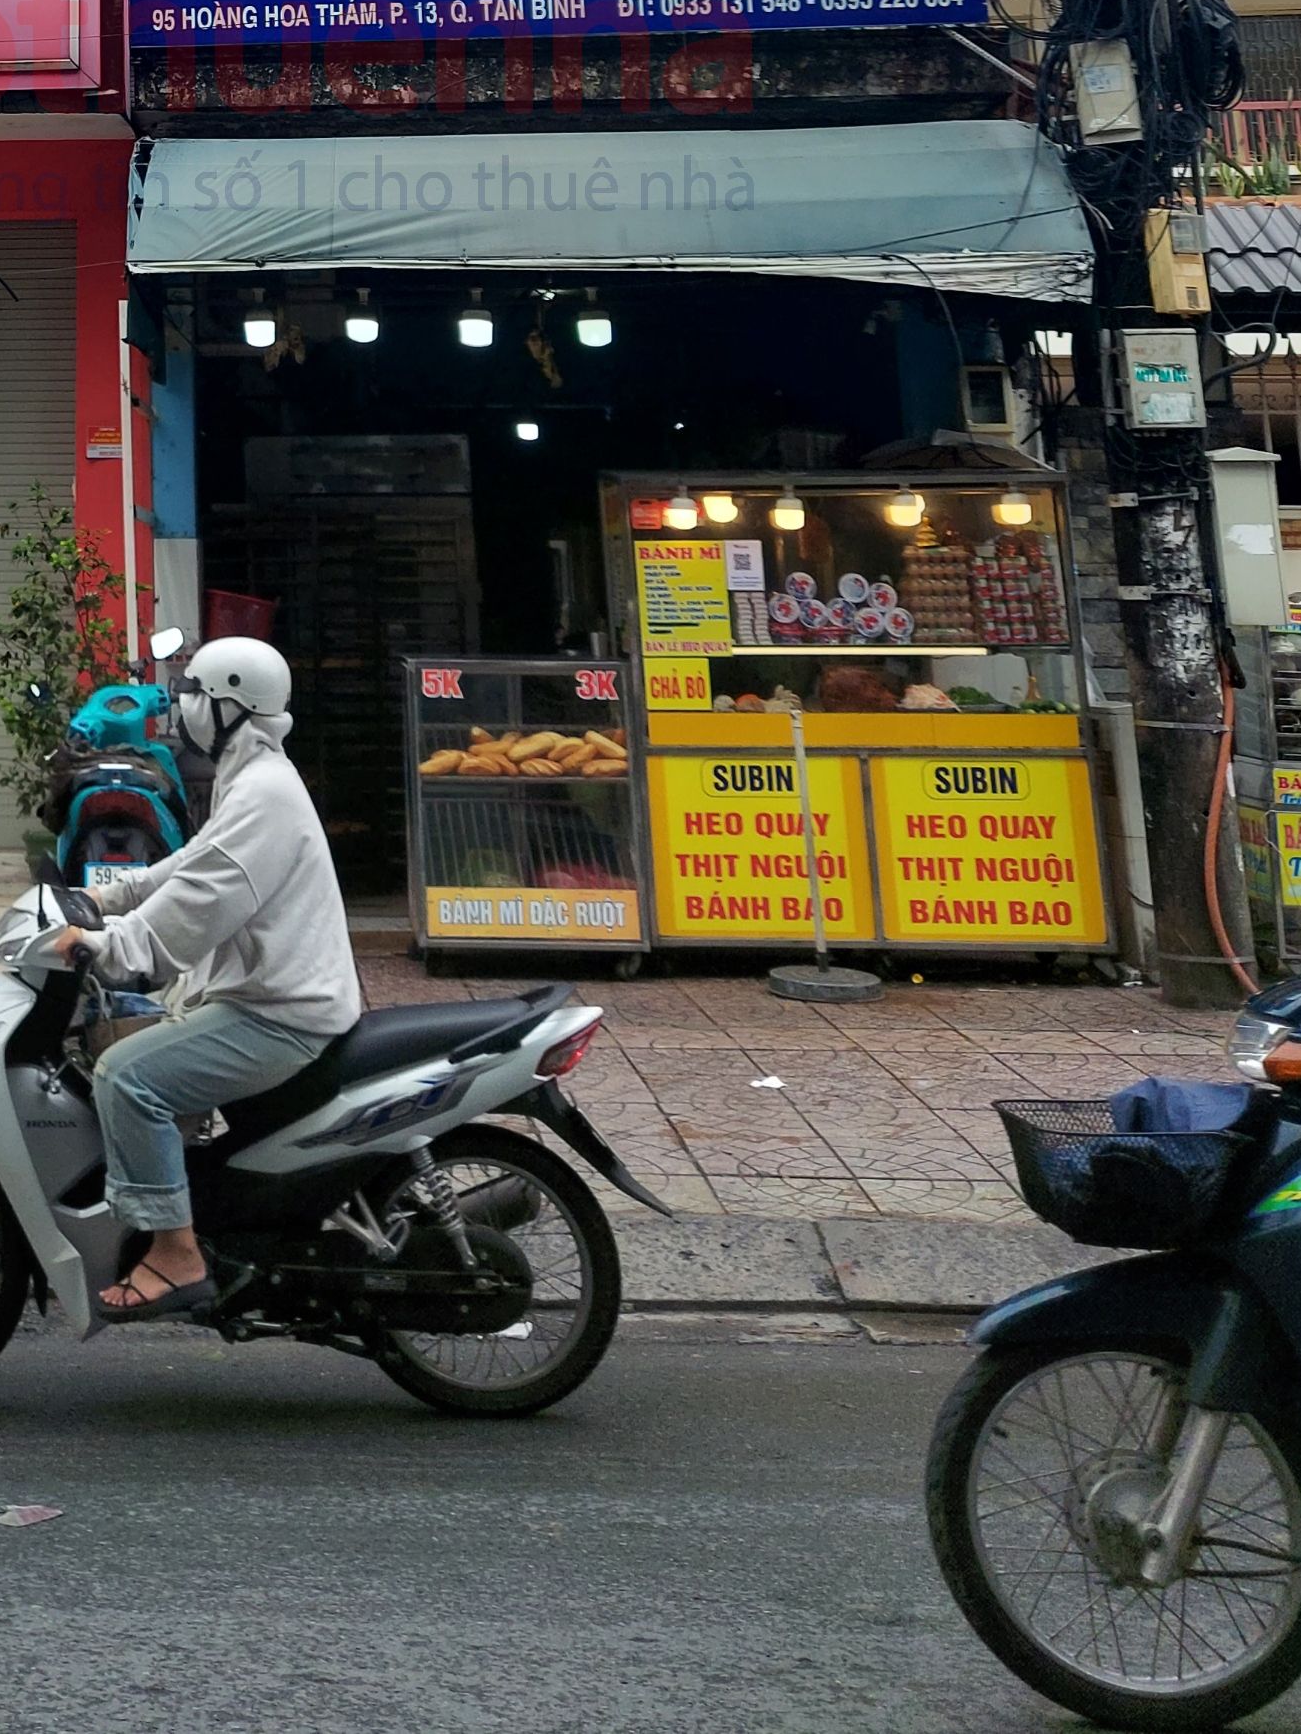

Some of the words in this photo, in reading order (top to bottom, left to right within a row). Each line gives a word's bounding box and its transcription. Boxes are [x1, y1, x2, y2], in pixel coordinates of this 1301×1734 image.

[152, 9, 175, 31] 95
[264, 4, 310, 28] HOA
[390, 2, 407, 24] P.
[414, 1, 444, 28] 13,
[450, 0, 474, 25] Q.
[421, 668, 464, 699] 5K
[575, 669, 620, 701] 3K
[713, 764, 795, 792] SUBIN
[934, 766, 1019, 795] SUBIN
[685, 812, 744, 836] HEO
[906, 814, 968, 839] HEO
[979, 814, 1056, 842] QUAY
[675, 853, 740, 883] THỊT
[751, 849, 847, 884] NGUỘI
[897, 857, 963, 886] THỊT
[975, 853, 1075, 888] NGUỘI
[439, 896, 493, 926] BÁNH
[500, 896, 523, 926] MÌ
[686, 891, 771, 920] BÁNH
[909, 894, 998, 925] BÁNH
[1008, 901, 1073, 926] BAO
